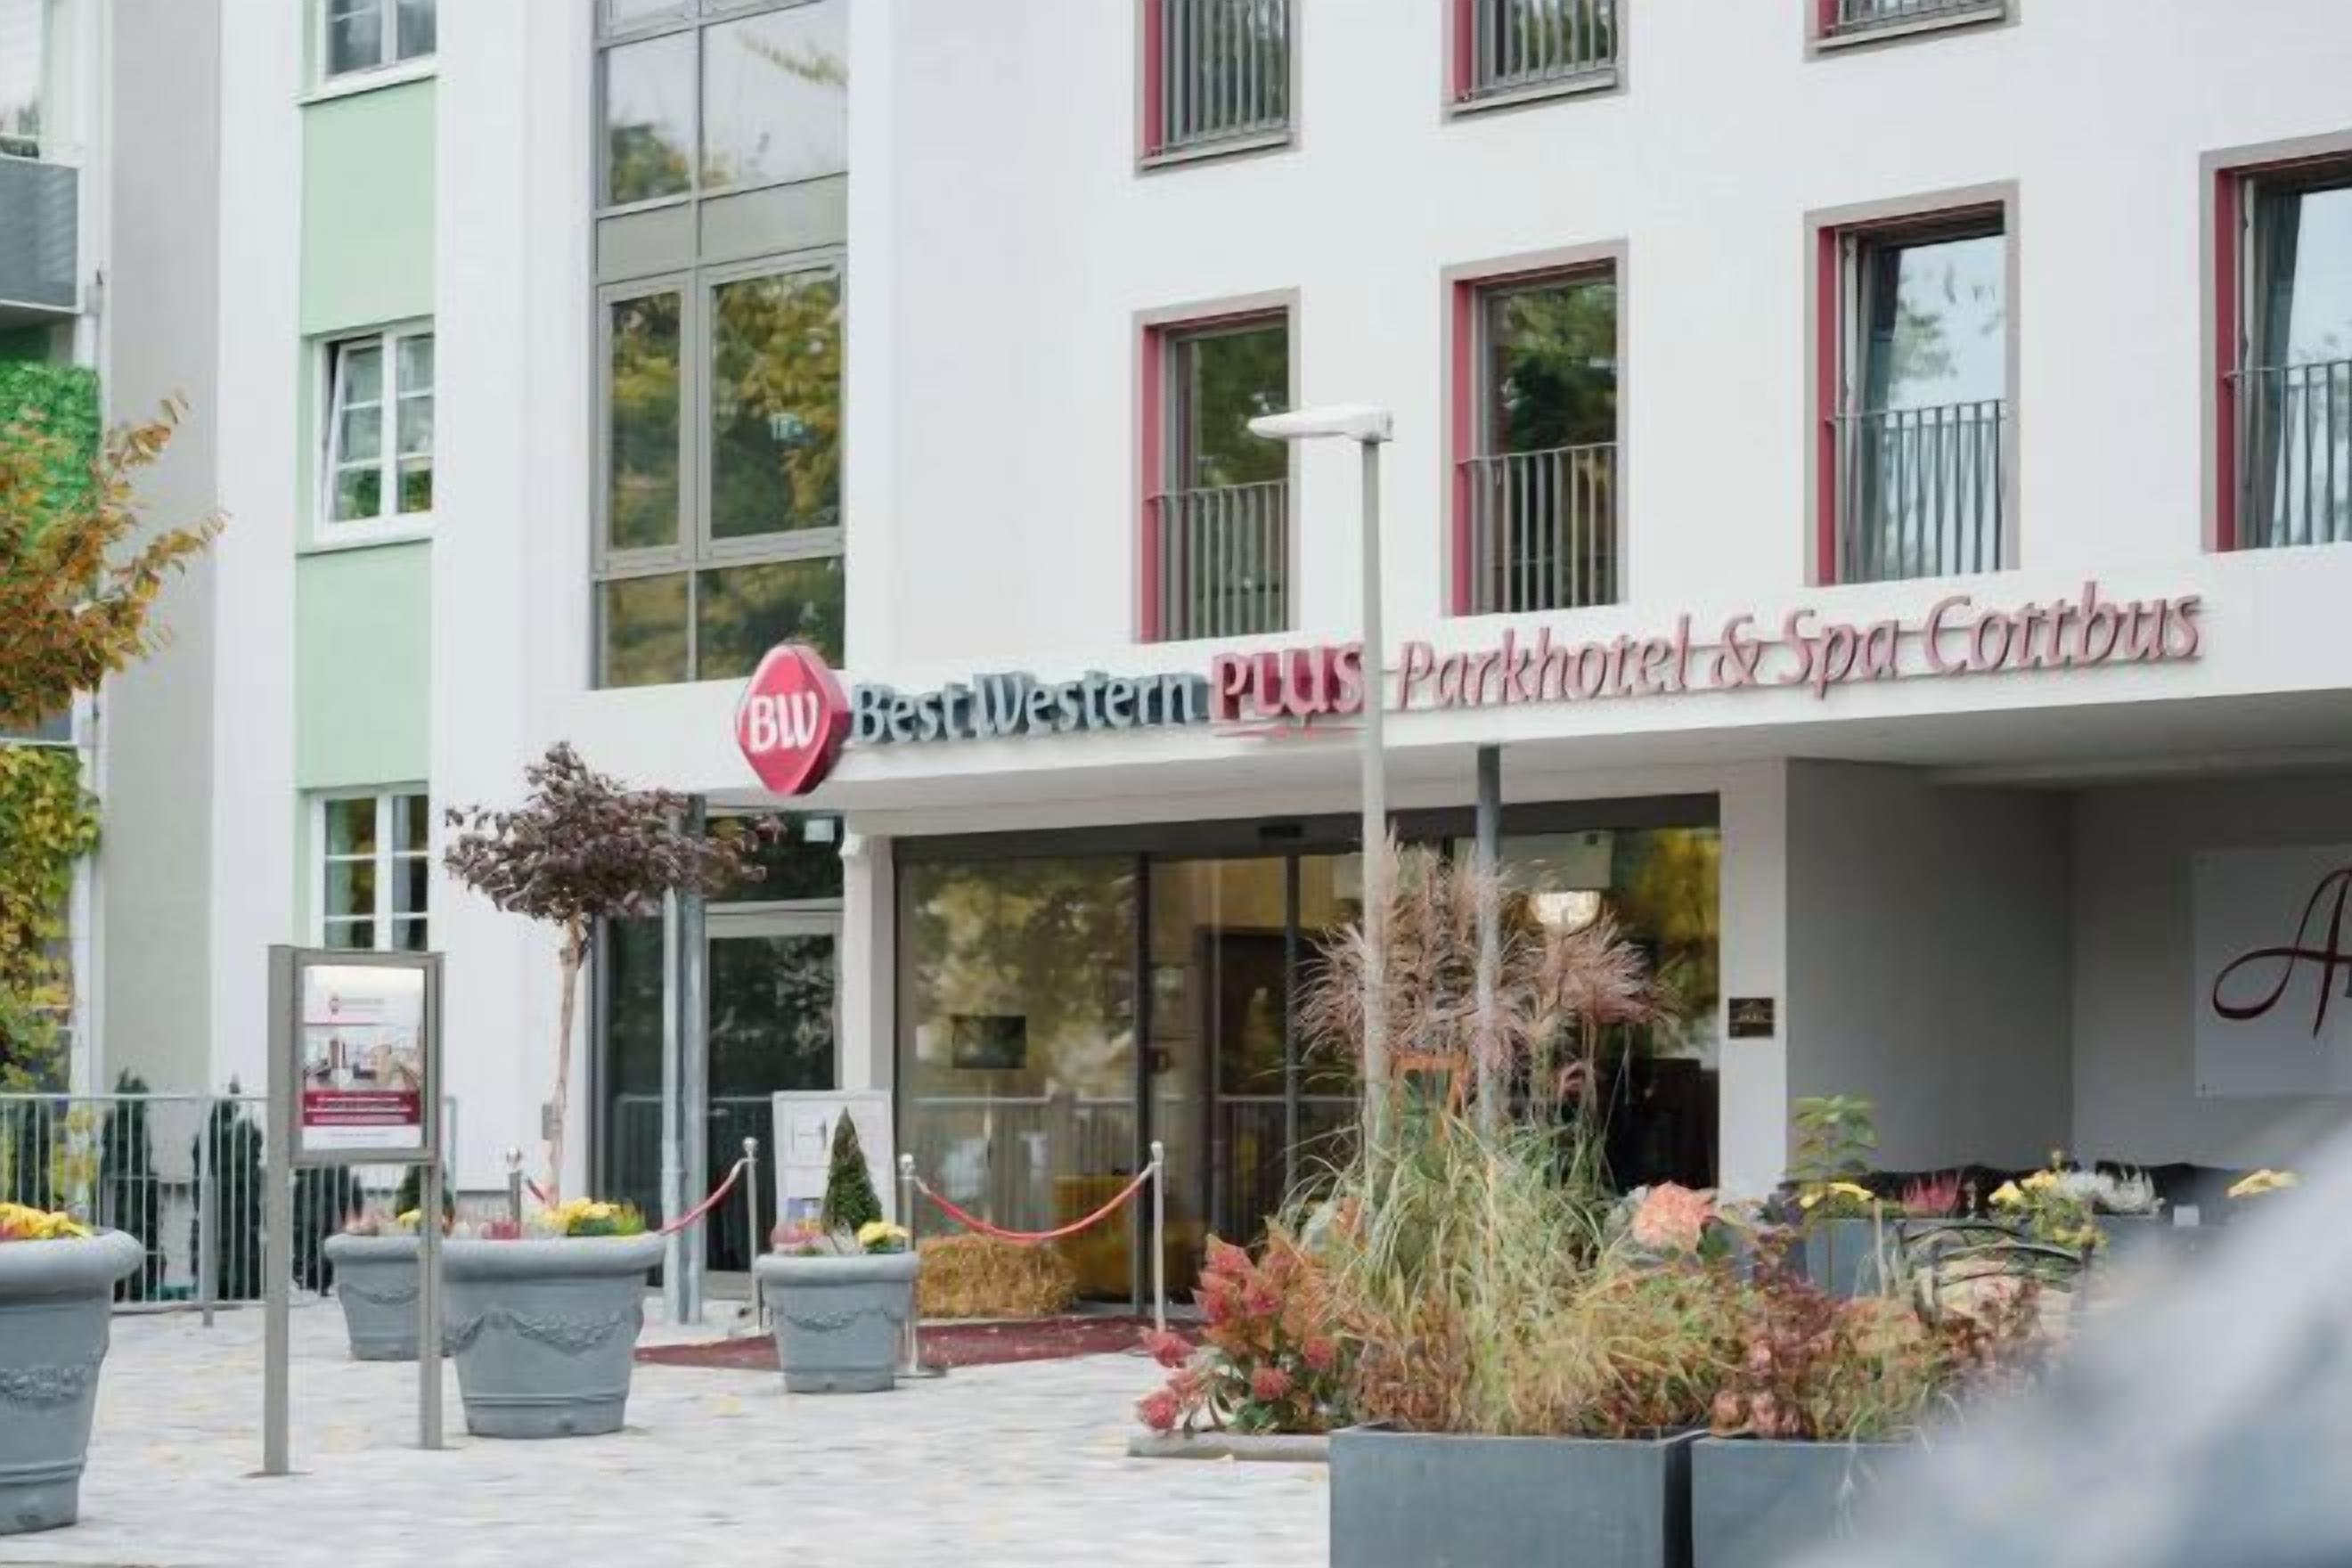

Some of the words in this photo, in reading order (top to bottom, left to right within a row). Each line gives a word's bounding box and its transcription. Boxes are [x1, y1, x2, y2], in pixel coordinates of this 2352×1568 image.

[851, 684, 968, 744] Best
[975, 670, 1207, 739] Western
[1213, 643, 1364, 723] PLUS
[1396, 615, 1690, 710] Parkhotel
[1710, 614, 1764, 688] &
[1780, 608, 1899, 698] Spa
[1923, 581, 2201, 674] Cottbus
[747, 693, 818, 752] BW
